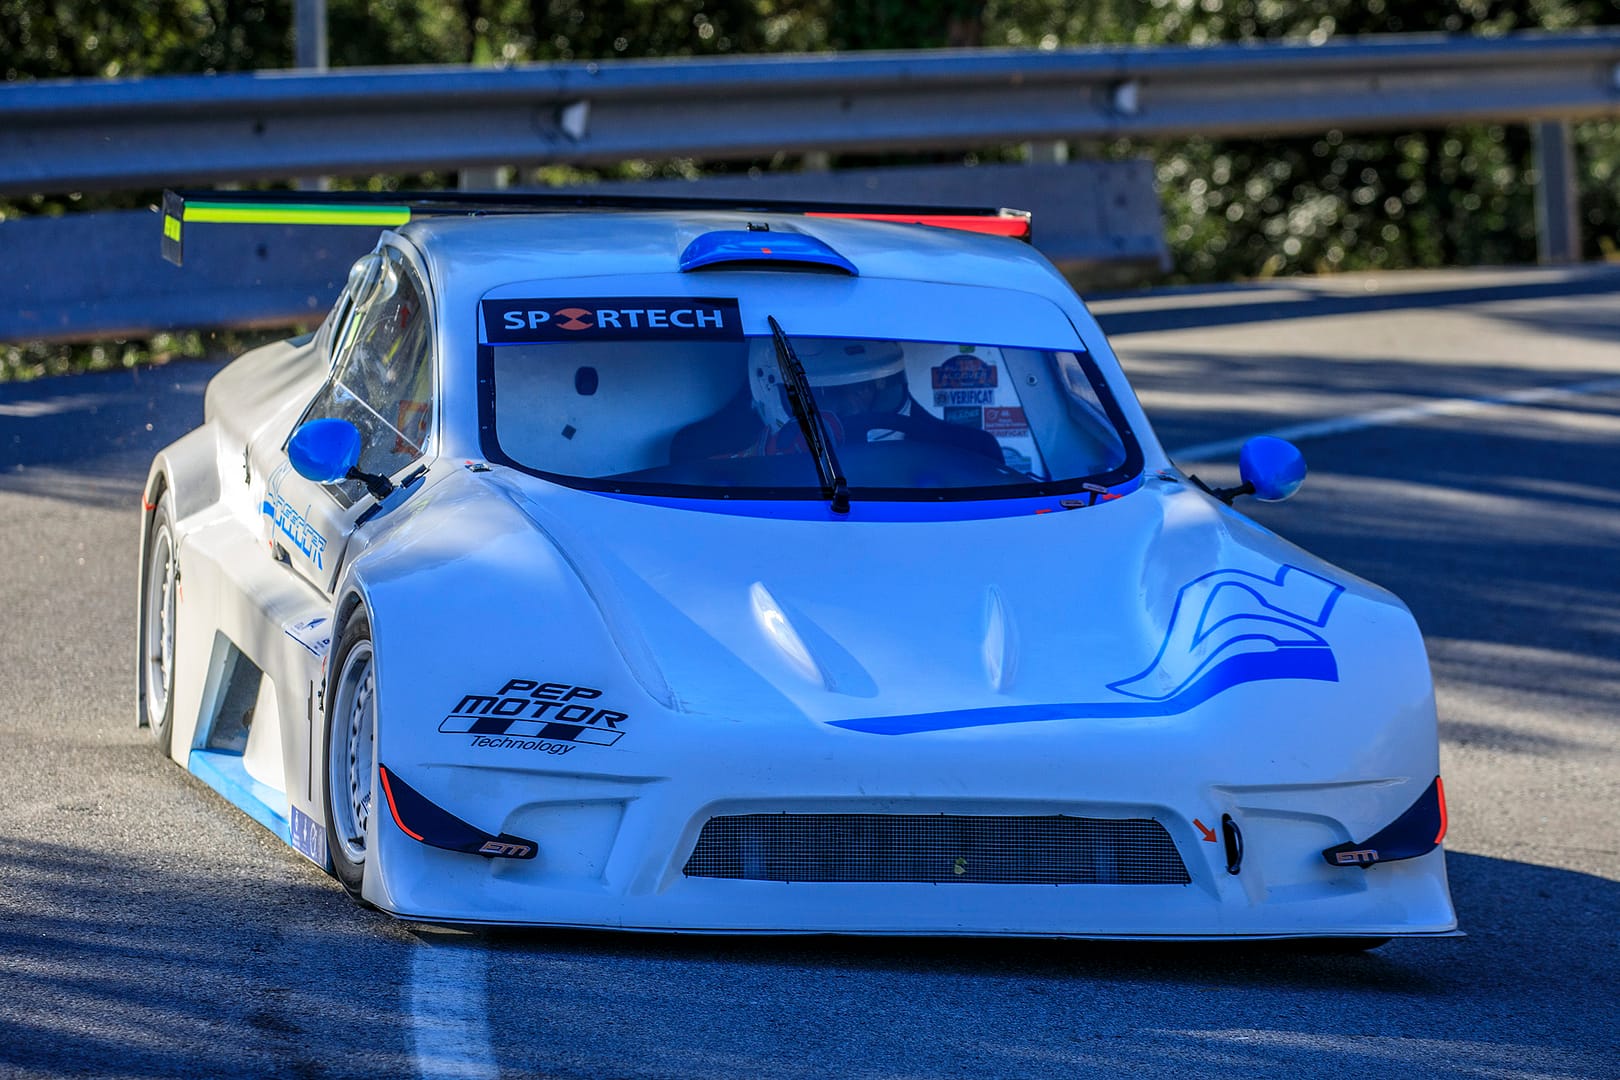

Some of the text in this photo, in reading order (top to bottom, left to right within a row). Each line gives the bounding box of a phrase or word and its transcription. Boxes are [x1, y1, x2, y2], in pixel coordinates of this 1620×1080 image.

[950, 390, 993, 404] VERIFICAT
[496, 679, 602, 702] PEP
[451, 695, 629, 729] MOTOR
[470, 735, 577, 756] Technology
